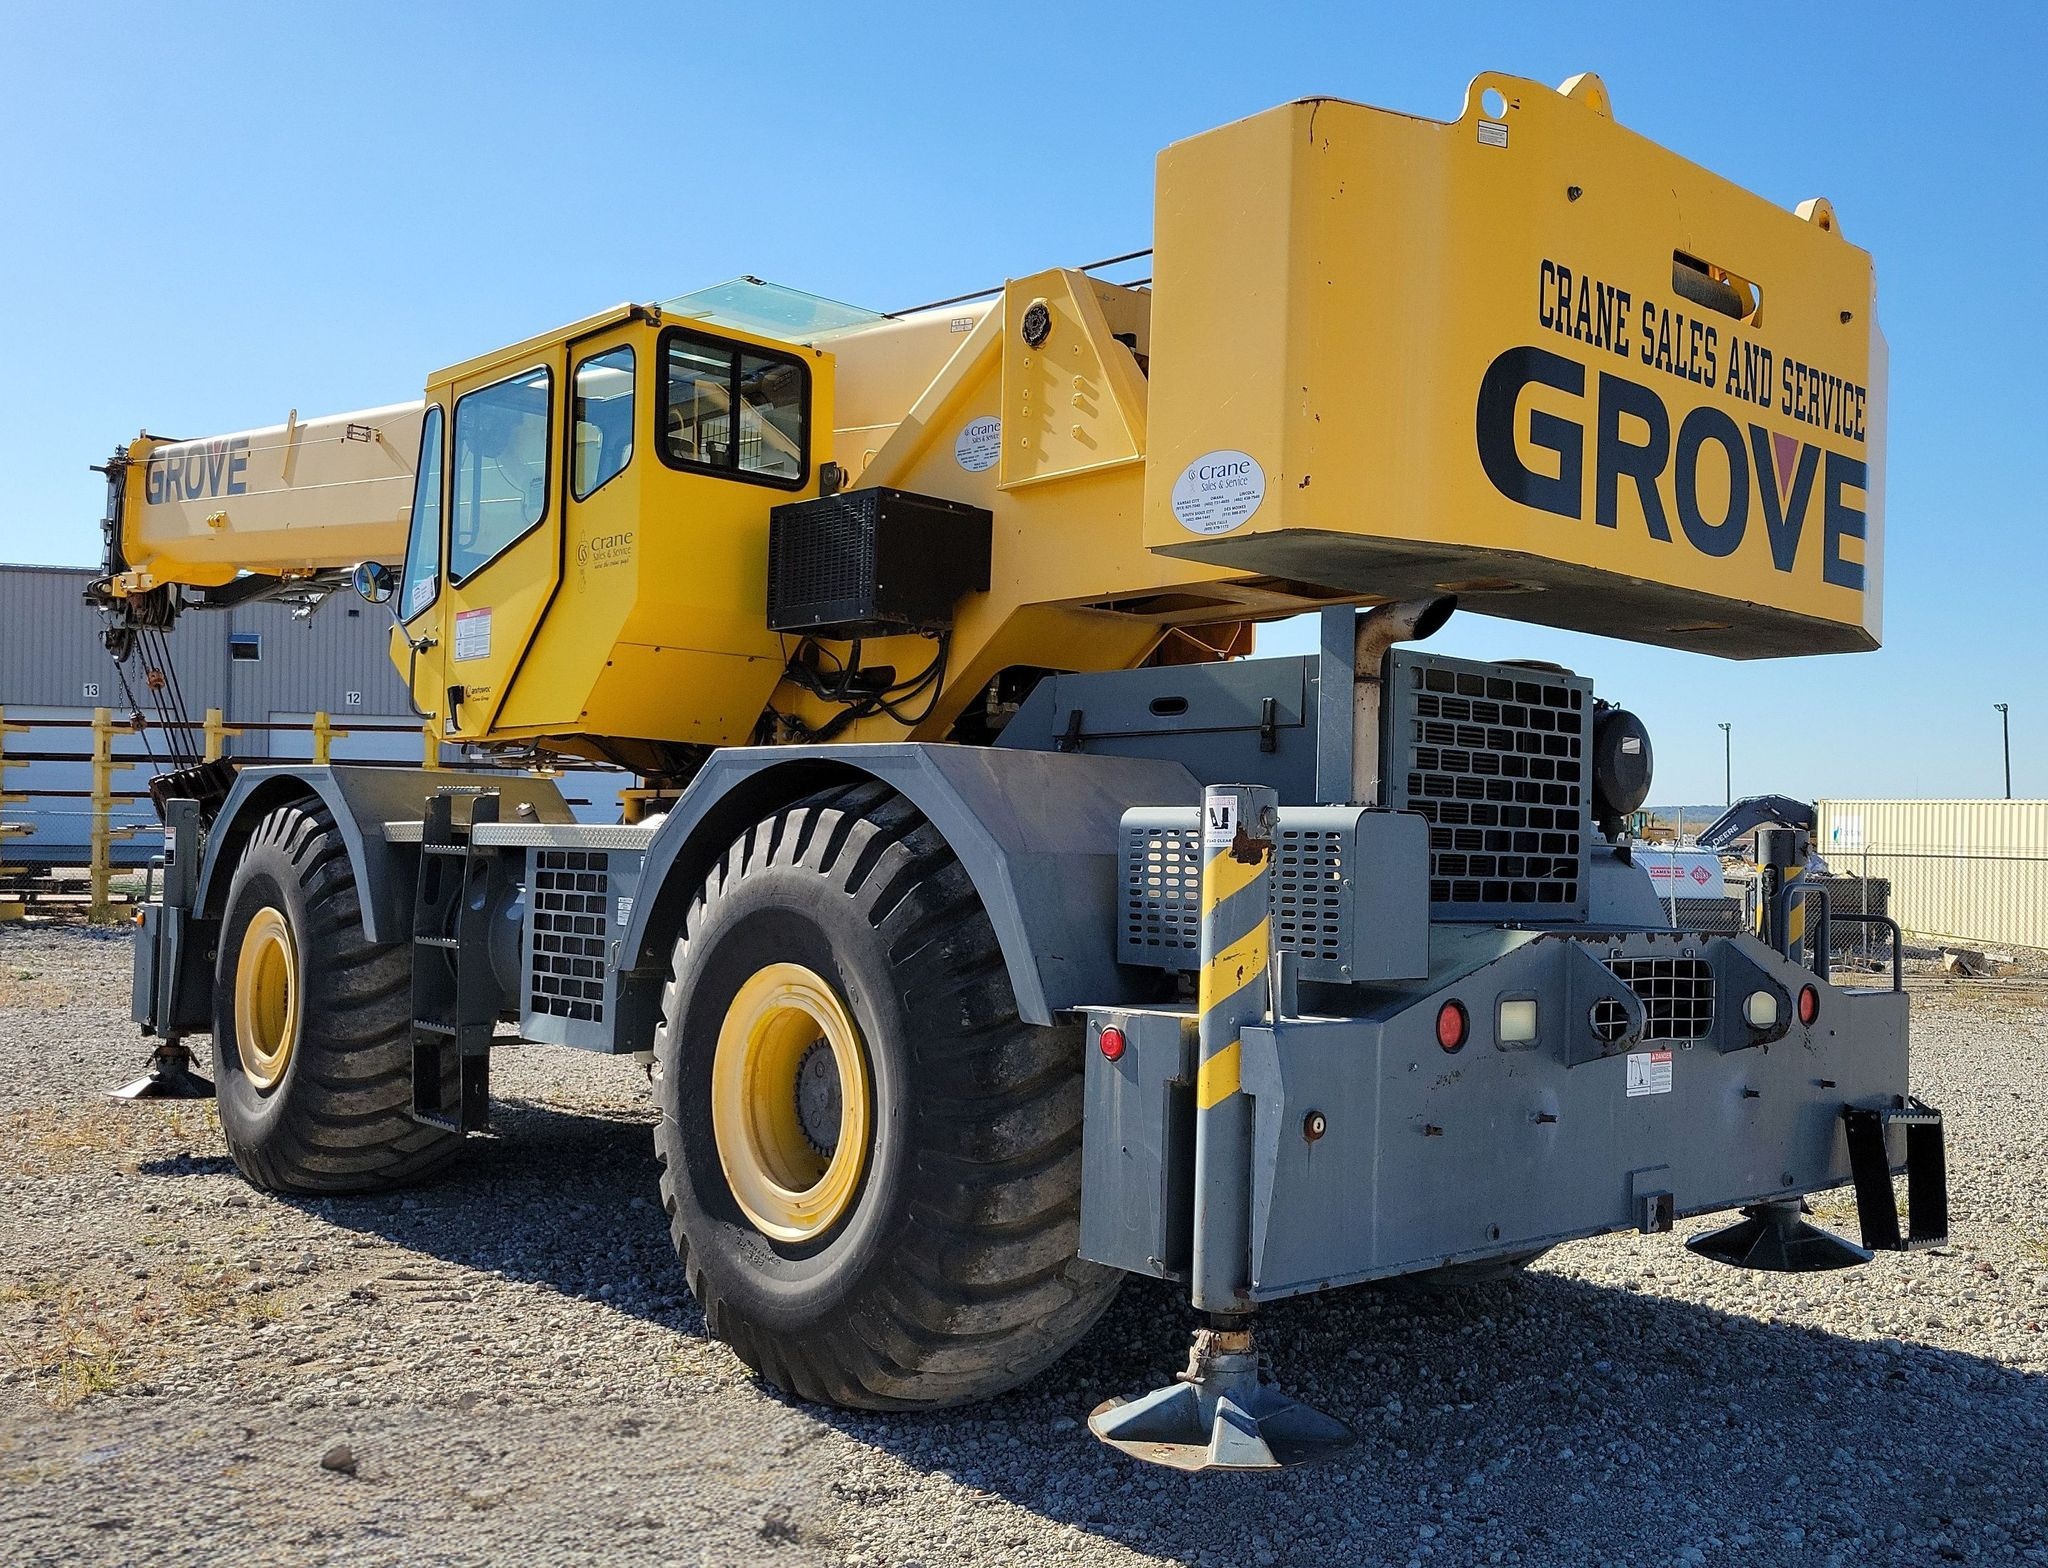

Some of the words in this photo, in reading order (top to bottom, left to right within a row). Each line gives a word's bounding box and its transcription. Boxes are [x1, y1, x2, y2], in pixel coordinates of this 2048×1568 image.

[1537, 258, 1630, 356] CRANE
[1640, 300, 1718, 389] SALES
[1726, 335, 1773, 409] AND
[1782, 357, 1867, 442] SERVICE
[971, 422, 1000, 437] Crane
[146, 437, 249, 505] GROVE
[1199, 461, 1250, 480] Crane
[1475, 345, 1868, 590] GROVE
[1201, 480, 1217, 492] Sales
[1219, 480, 1224, 489] &
[1226, 475, 1248, 488] Service
[591, 531, 633, 551] Crane
[84, 684, 98, 696] 13
[348, 693, 360, 704] 12
[1712, 824, 1739, 846] DEERE
